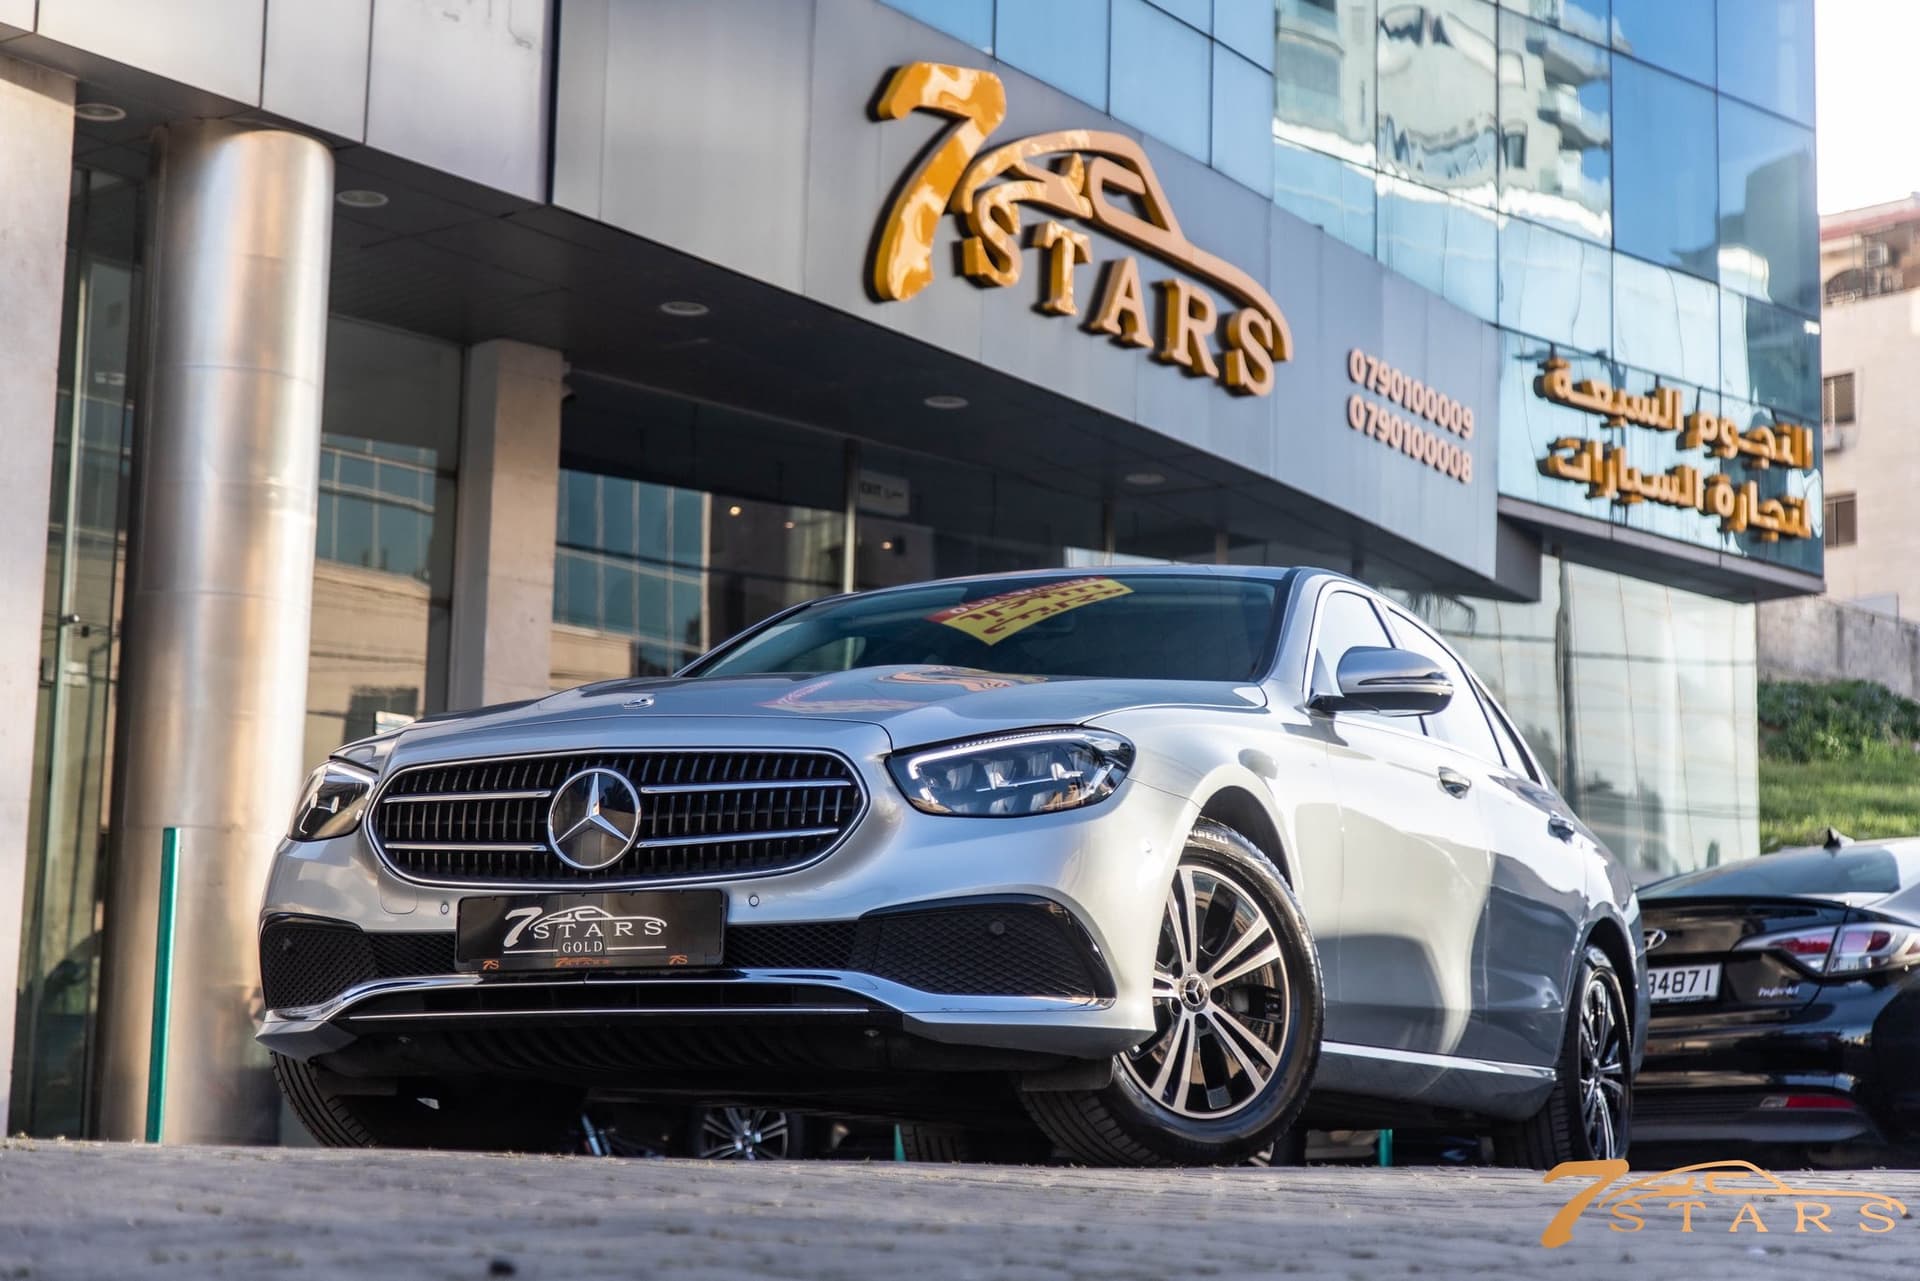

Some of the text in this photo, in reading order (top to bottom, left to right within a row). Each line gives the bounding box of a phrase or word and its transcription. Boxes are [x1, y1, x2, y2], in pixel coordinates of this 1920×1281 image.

[865, 61, 1276, 397] 7 STARS
[1347, 347, 1473, 440] 0790100009
[1347, 393, 1473, 484] 0790100008
[1542, 357, 1814, 470] النجوم السبعة
[1546, 437, 1812, 542] لتجارة السيارات
[503, 906, 663, 948] 7 STARS
[562, 941, 603, 953] GOLD
